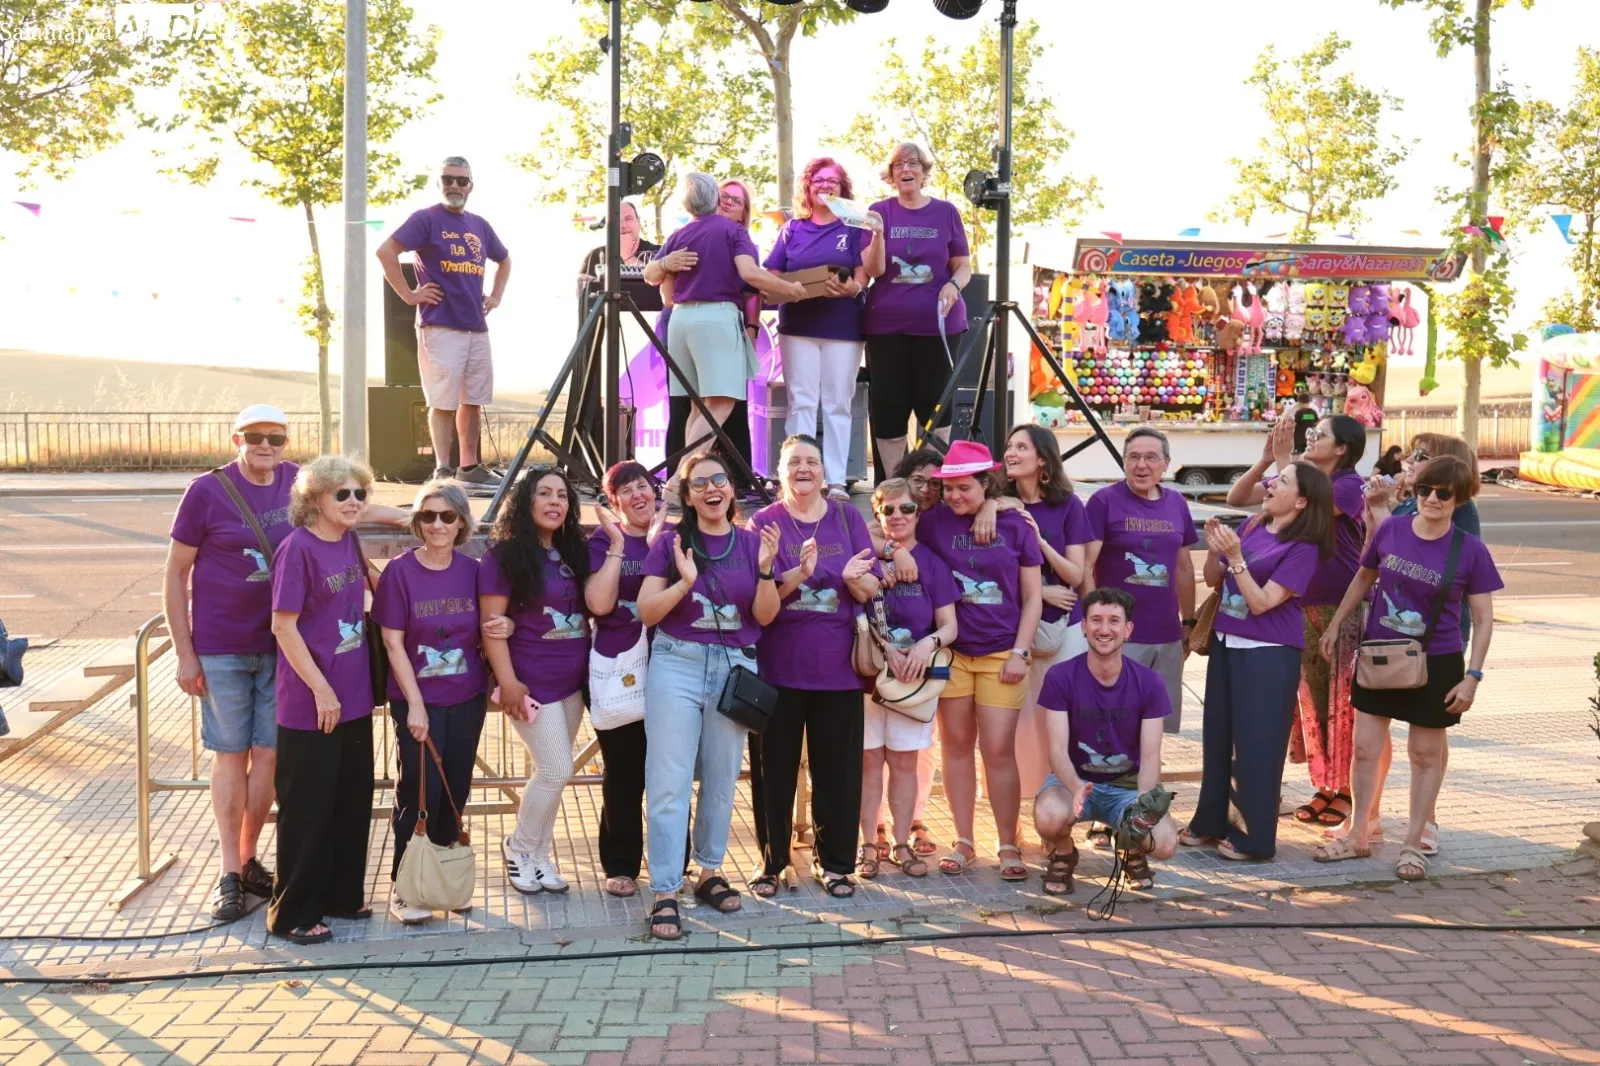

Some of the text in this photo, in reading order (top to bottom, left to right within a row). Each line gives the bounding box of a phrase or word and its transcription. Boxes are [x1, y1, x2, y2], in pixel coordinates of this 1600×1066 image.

[451, 244, 466, 256] La
[1119, 250, 1175, 266] Caseta
[1184, 252, 1243, 272] Juegos
[1298, 254, 1425, 273] Saray&Nazareth
[1384, 554, 1441, 587] INVISIBLES
